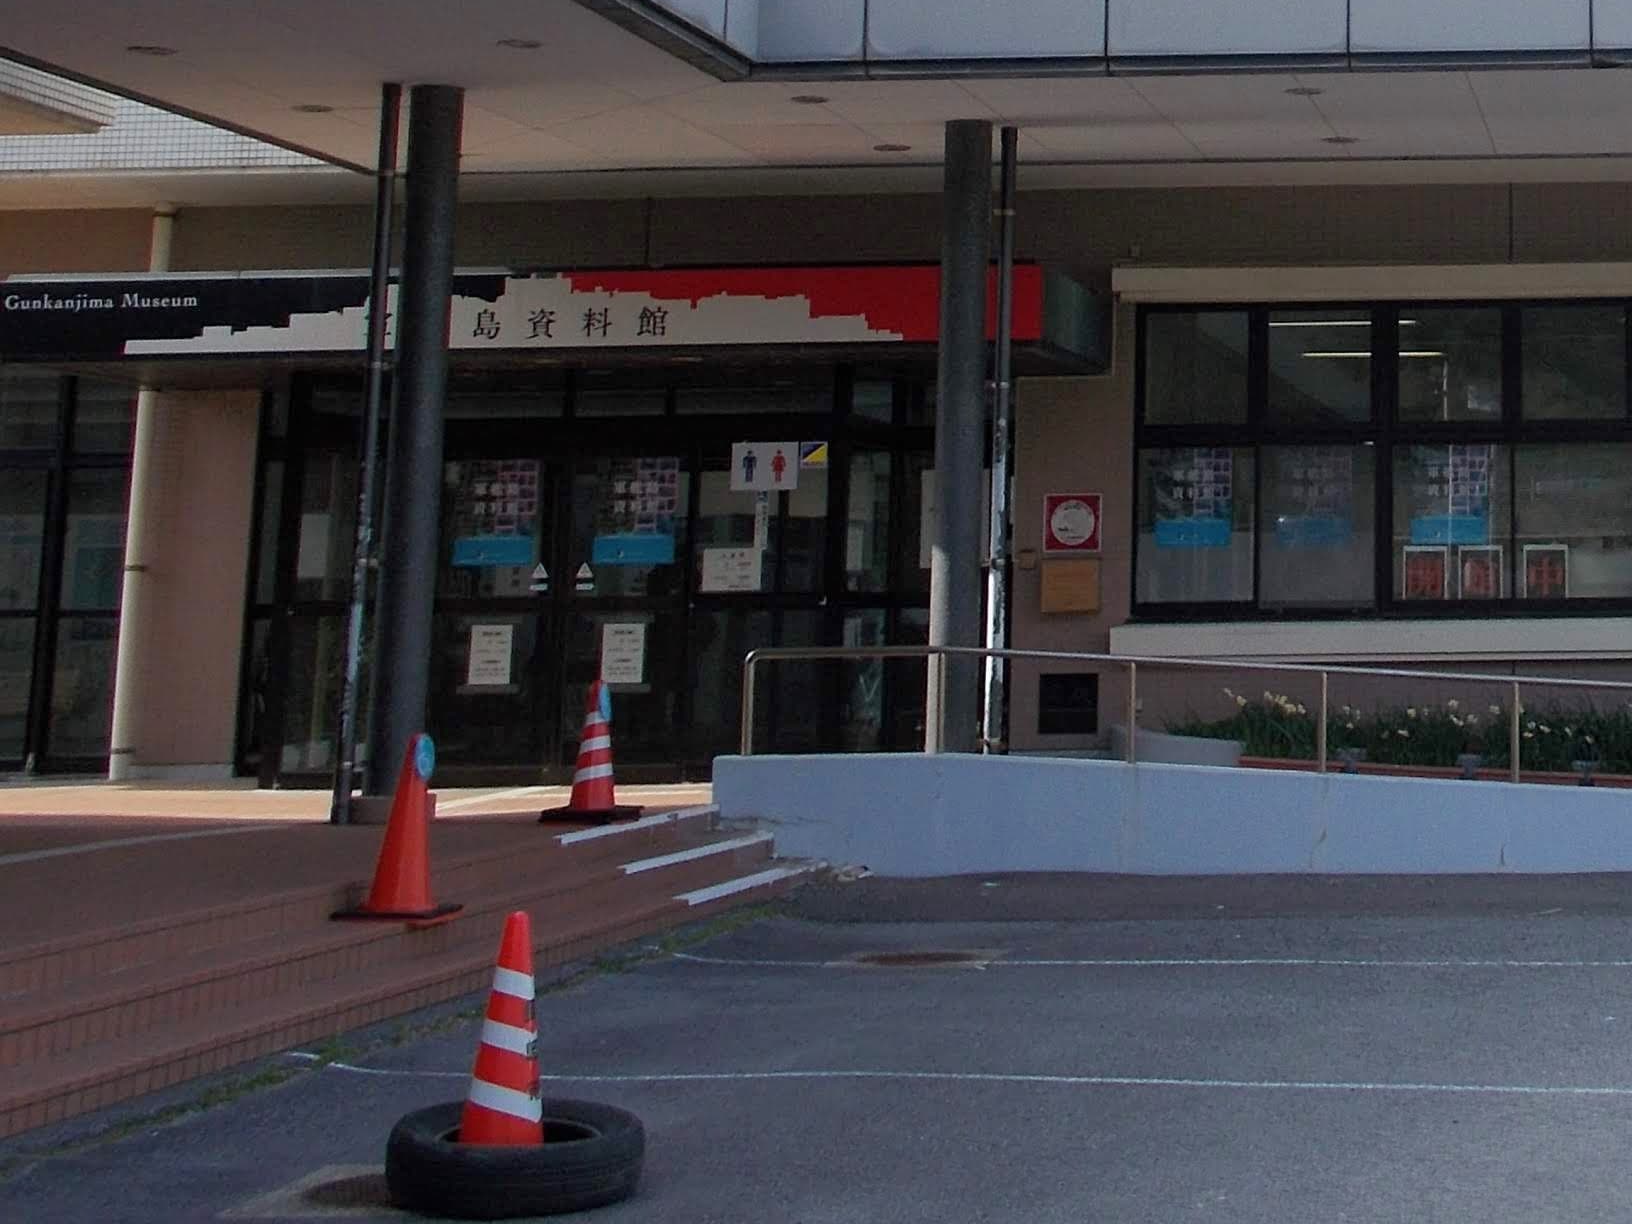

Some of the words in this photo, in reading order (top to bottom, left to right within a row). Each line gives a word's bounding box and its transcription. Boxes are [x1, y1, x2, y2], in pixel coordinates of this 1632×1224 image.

[4, 292, 114, 313] Gunkanjima
[121, 292, 198, 309] Museum
[363, 306, 669, 341] 島資料館
